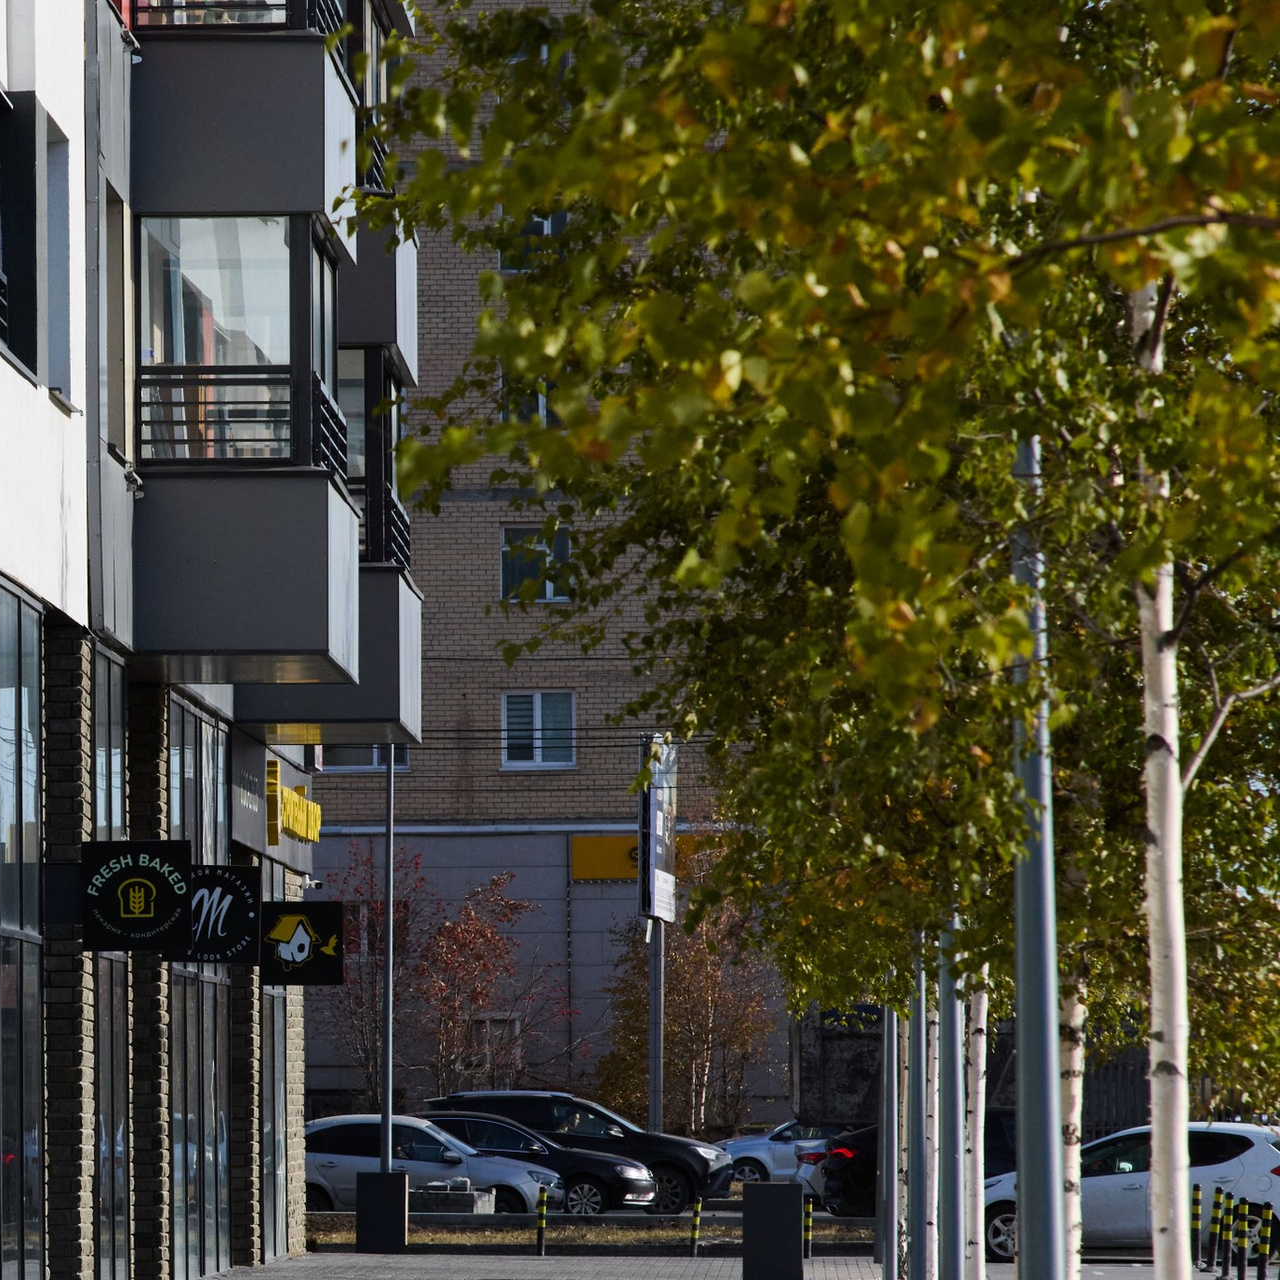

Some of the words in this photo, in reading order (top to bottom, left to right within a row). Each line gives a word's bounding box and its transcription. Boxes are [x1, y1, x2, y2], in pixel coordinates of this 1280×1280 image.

[87, 853, 133, 897] FRESH
[138, 853, 187, 895] BAKED
[216, 869, 254, 905] МАГАЗИН
[92, 908, 122, 936] пекарня
[130, 907, 182, 939] кондитерская
[197, 952, 222, 960] LOOK
[226, 935, 252, 958] STORE
